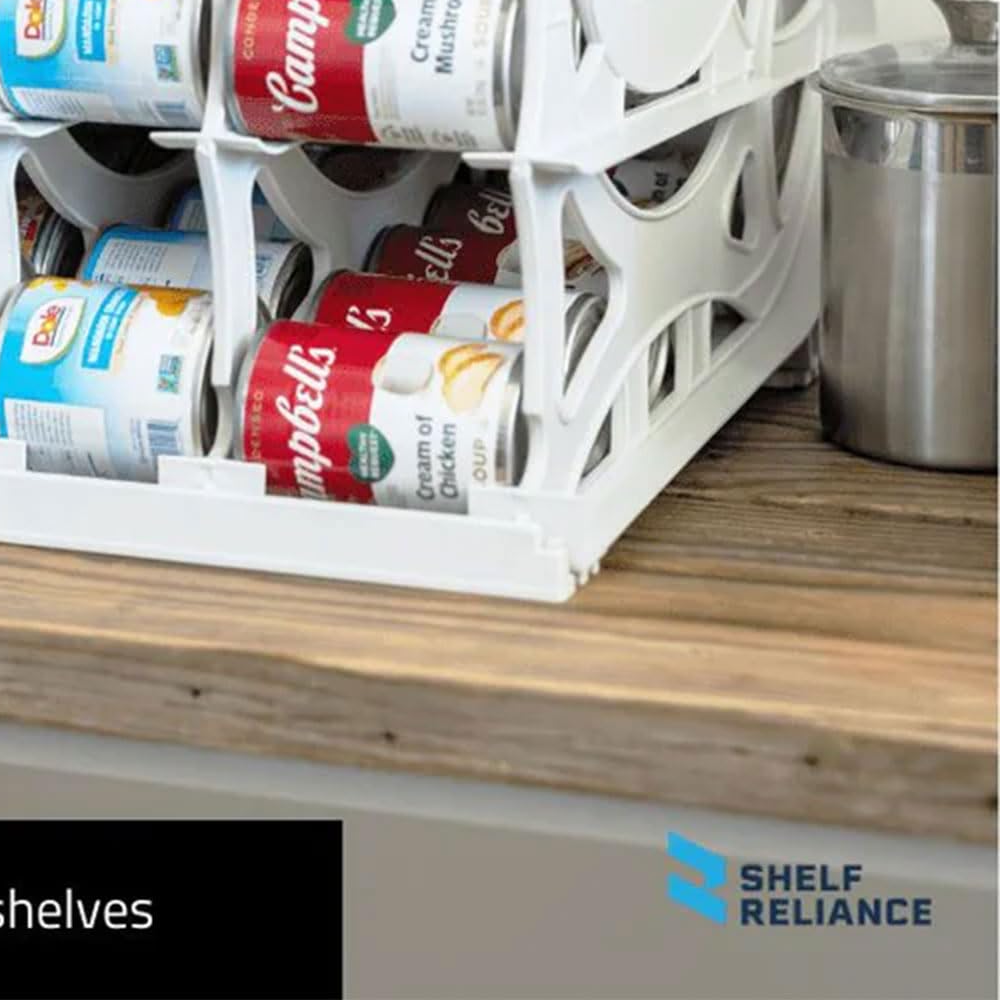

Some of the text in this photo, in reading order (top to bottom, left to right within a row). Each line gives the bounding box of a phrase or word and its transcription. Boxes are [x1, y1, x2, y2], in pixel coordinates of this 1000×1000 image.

[32, 305, 62, 346] Dole
[276, 344, 336, 498] mpbell's
[416, 414, 434, 500] Cream of
[437, 424, 458, 498] Chicken
[472, 438, 487, 483] OUP
